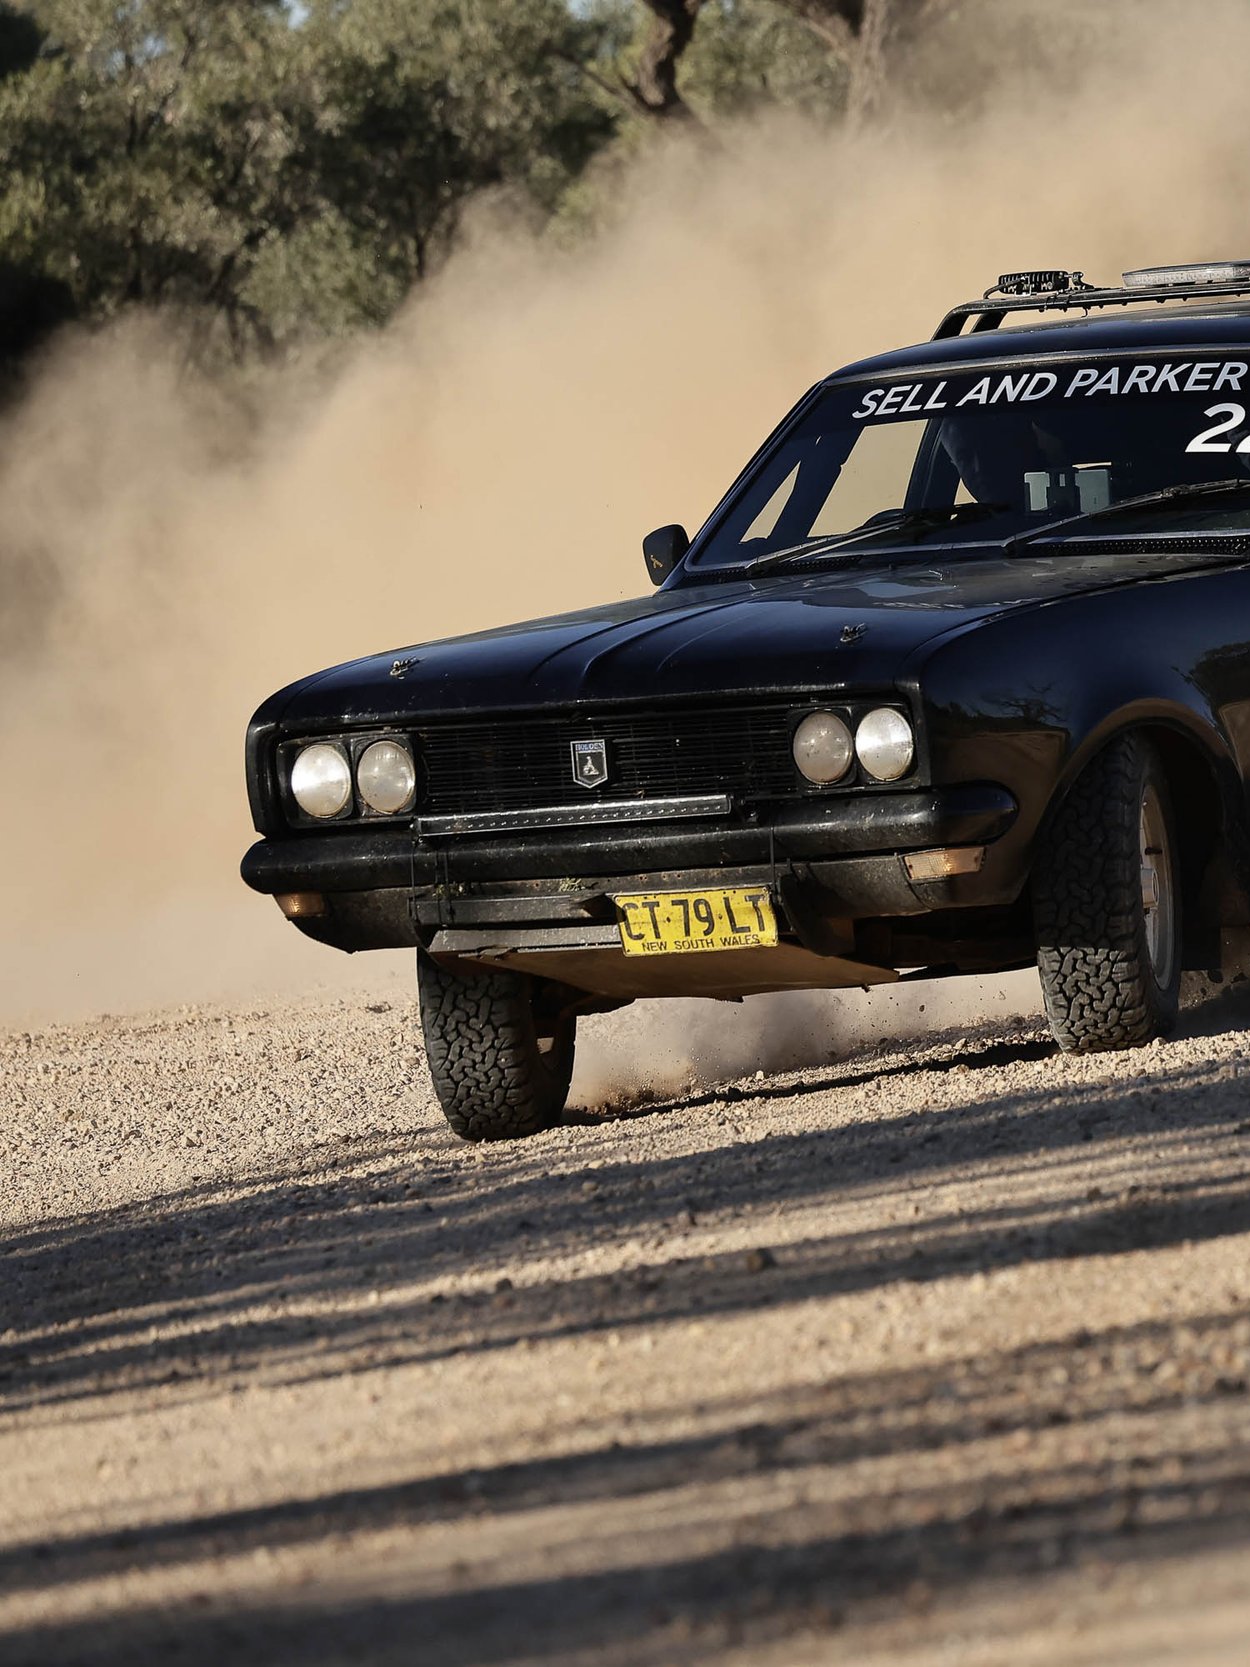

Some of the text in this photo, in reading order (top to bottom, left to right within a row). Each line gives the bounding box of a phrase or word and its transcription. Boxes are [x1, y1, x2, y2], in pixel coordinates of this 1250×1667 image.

[852, 361, 1248, 419] SELL AND PARKER
[641, 934, 761, 952] NEW SOUTH WALES
